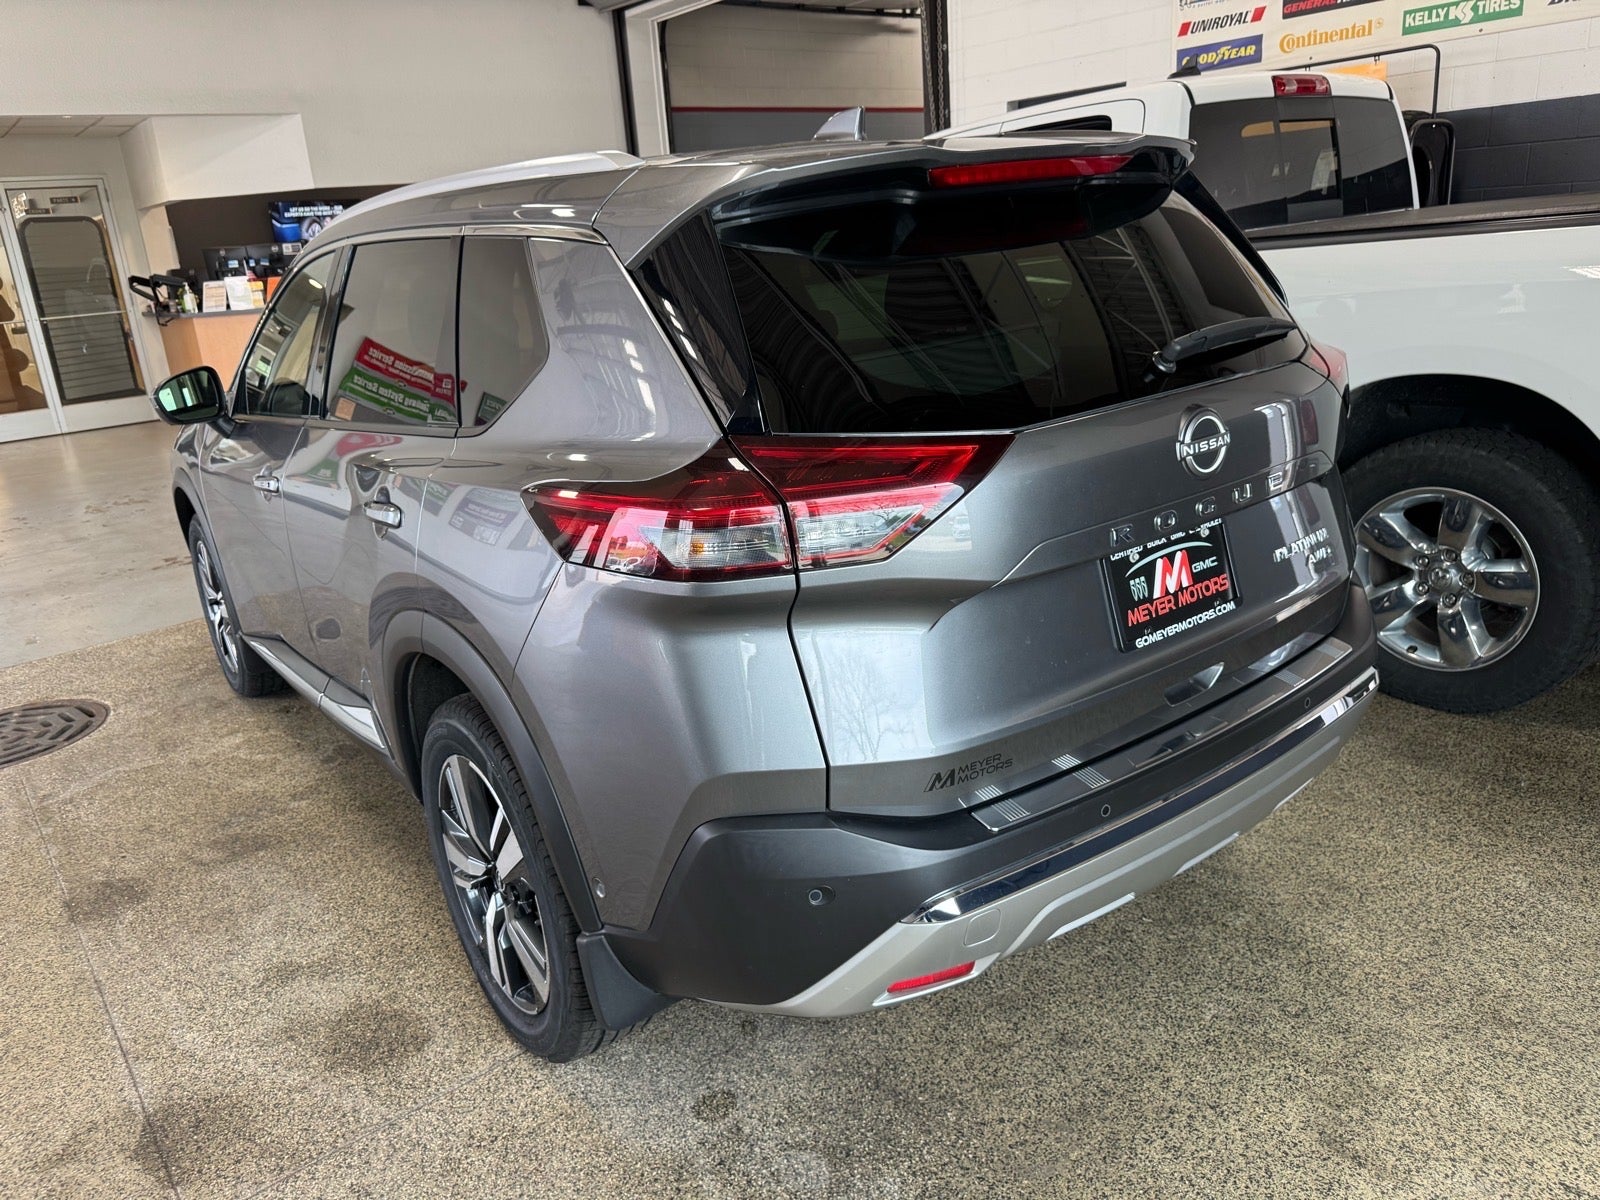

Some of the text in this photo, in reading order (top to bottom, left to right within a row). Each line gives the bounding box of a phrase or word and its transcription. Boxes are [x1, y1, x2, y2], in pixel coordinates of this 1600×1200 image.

[1190, 11, 1250, 34] UNIROYAL
[1405, 7, 1448, 28] KELLY
[1477, 0, 1521, 15] TIRES
[1279, 19, 1373, 54] Continental
[1182, 433, 1231, 457] NISSAN
[1109, 472, 1283, 548] ROGUE
[1192, 556, 1218, 573] GMC
[1127, 573, 1229, 627] MEYER MOTORS
[1135, 600, 1236, 649] GOMEYERMOTORS.COM
[957, 758, 1013, 785] MOTORS
[958, 753, 1002, 775] MEYER
